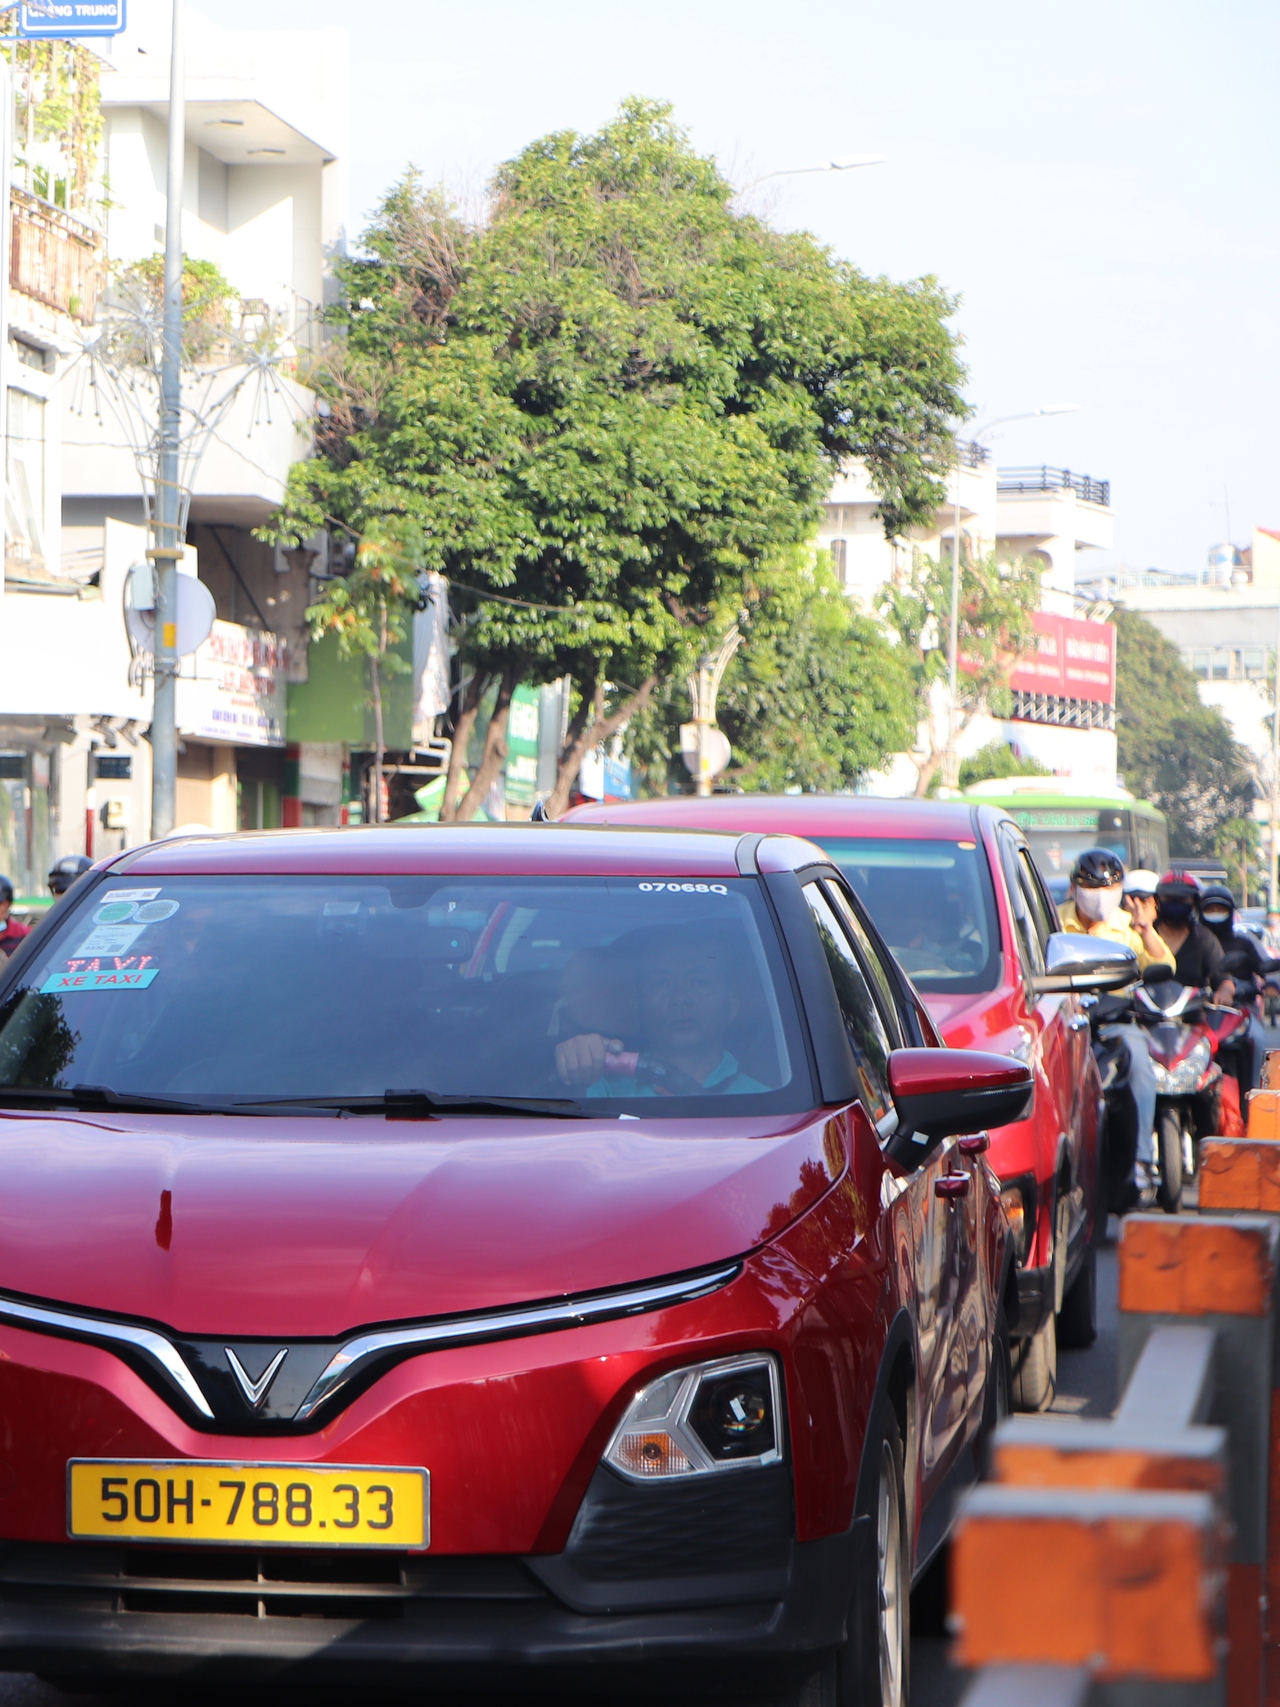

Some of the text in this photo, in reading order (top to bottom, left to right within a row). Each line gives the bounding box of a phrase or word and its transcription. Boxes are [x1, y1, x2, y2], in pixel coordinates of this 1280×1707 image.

[75, 4, 117, 16] TRUNG
[638, 882, 728, 896] 07068Q
[57, 974, 143, 988] XE TAXI
[101, 1477, 395, 1530] 50H-788.33
